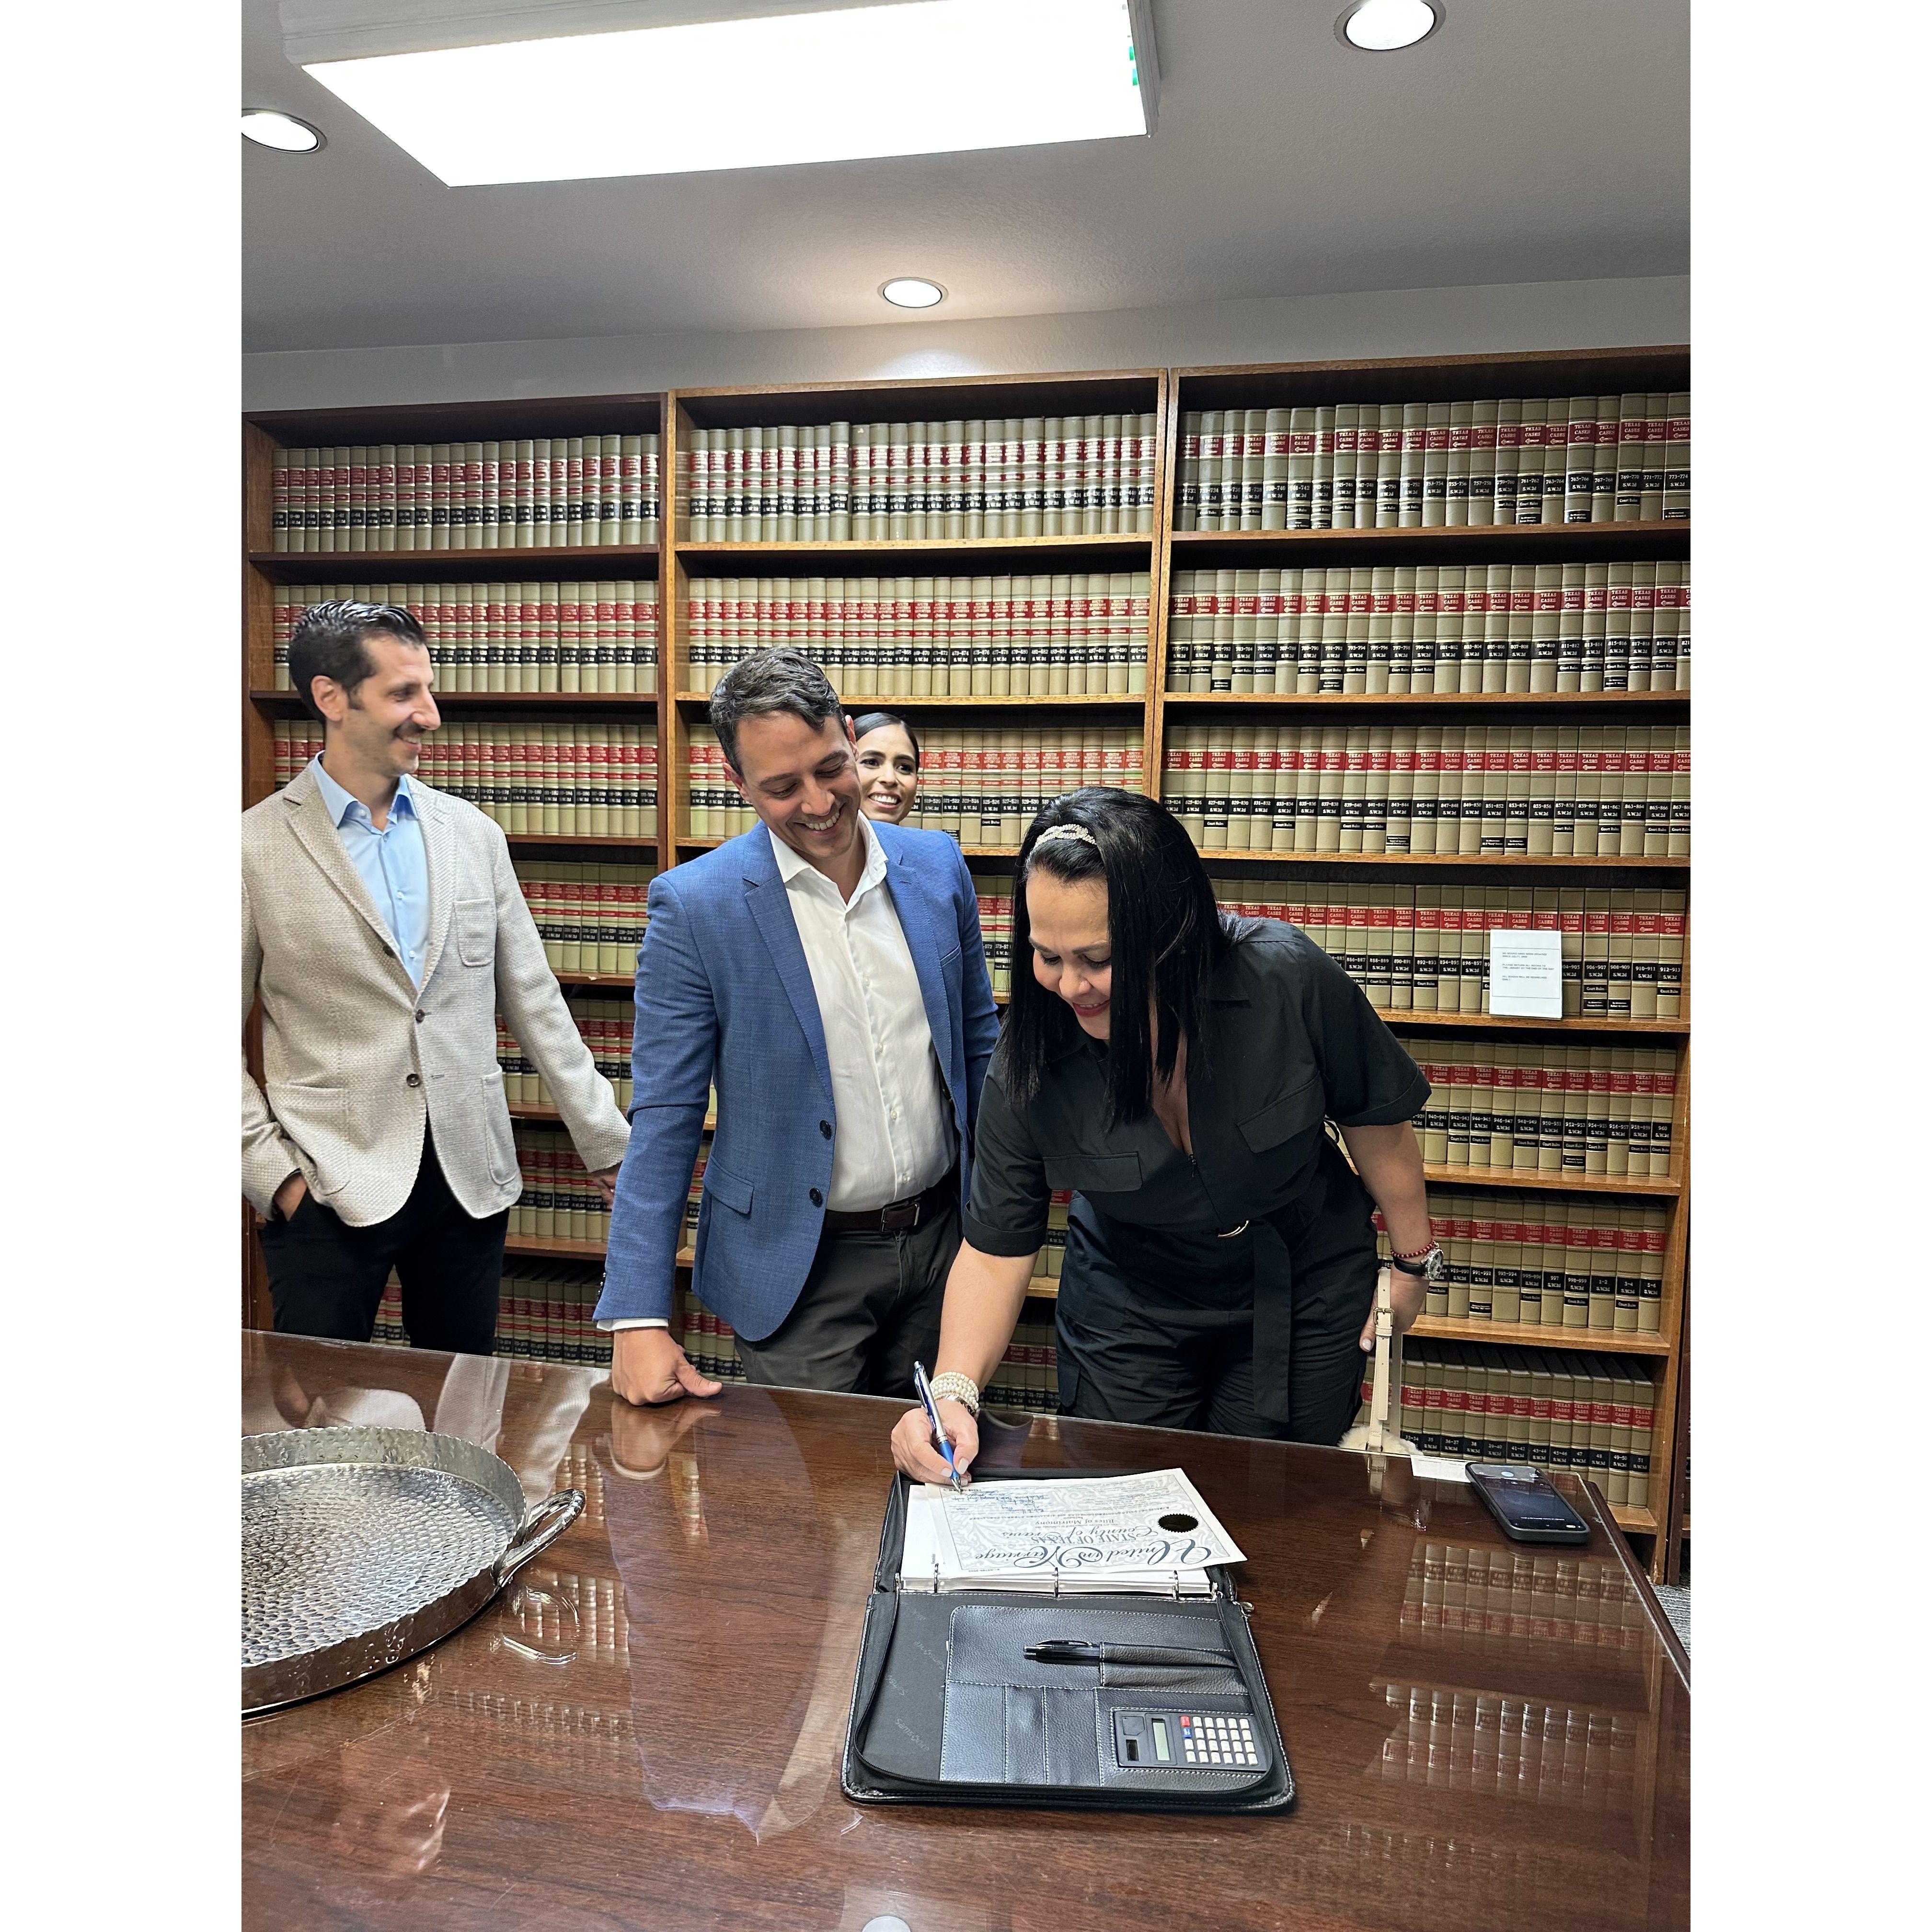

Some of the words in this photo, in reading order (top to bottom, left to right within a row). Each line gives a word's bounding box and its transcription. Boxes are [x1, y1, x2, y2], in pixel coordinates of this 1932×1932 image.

[1000, 1531, 1061, 1541] Travis
[1067, 1527, 1083, 1539] of
[1089, 1526, 1159, 1537] County
[1075, 1535, 1093, 1544] OF
[1094, 1533, 1136, 1544] STATE
[975, 1546, 1081, 1568] Marriage
[1106, 1539, 1211, 1565] United
[895, 1717, 930, 1752] Samsonite
